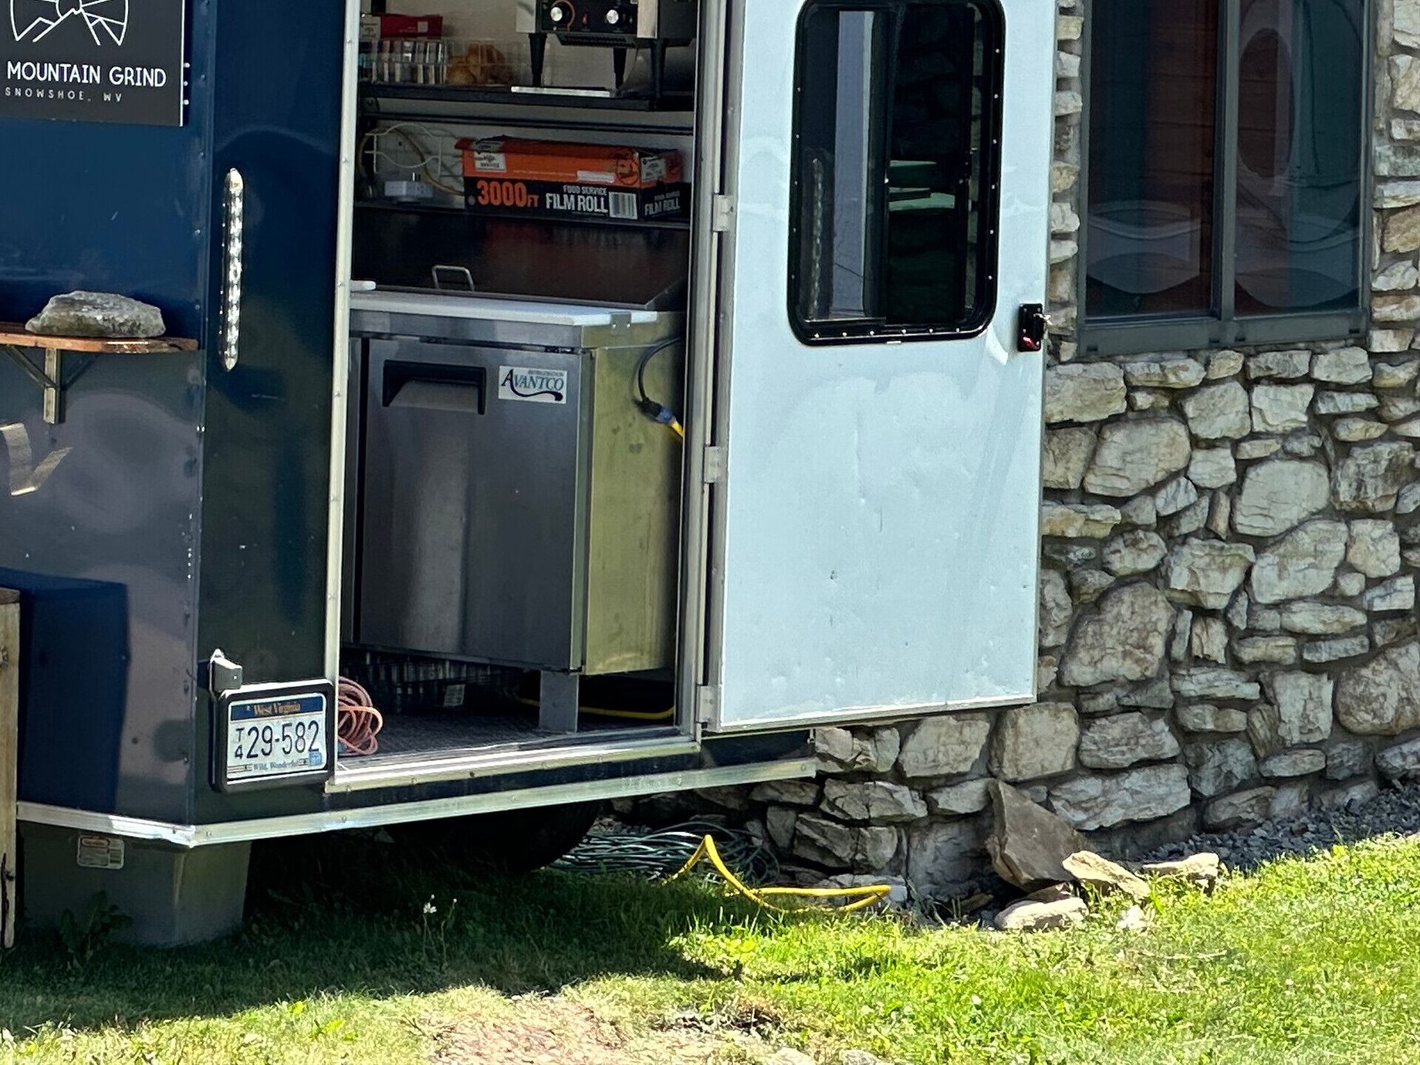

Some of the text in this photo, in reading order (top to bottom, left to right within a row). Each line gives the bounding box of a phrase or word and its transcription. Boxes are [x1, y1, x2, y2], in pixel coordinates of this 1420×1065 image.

[8, 61, 101, 84] MOUNTAIN
[109, 67, 166, 88] GRIND
[103, 93, 122, 103] WV
[546, 193, 608, 213] FILM ROLL
[501, 369, 564, 395] AVANTCO
[246, 720, 320, 759] 29-582
